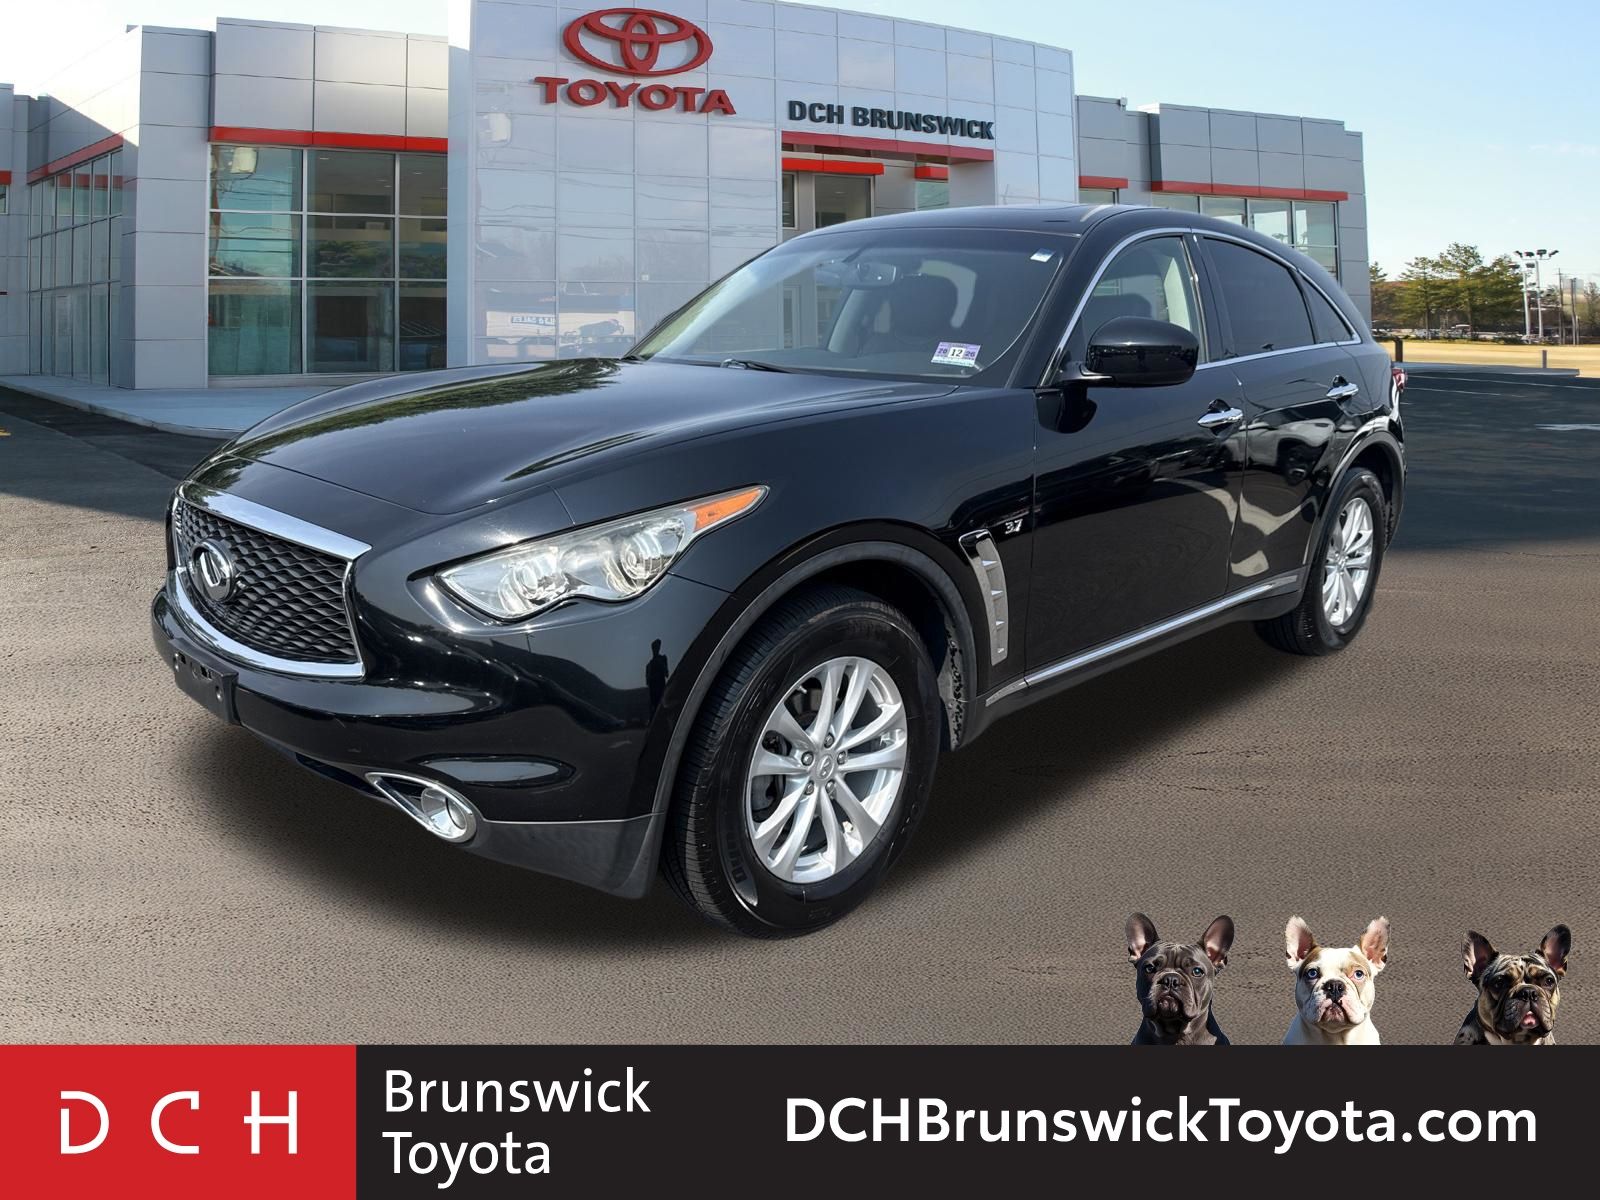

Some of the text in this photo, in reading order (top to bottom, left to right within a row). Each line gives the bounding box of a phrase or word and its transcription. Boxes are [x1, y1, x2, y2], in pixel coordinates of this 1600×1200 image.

[534, 76, 736, 115] TOYOTA
[788, 100, 995, 140] DCH BRUNSWICK
[951, 348, 963, 357] 12
